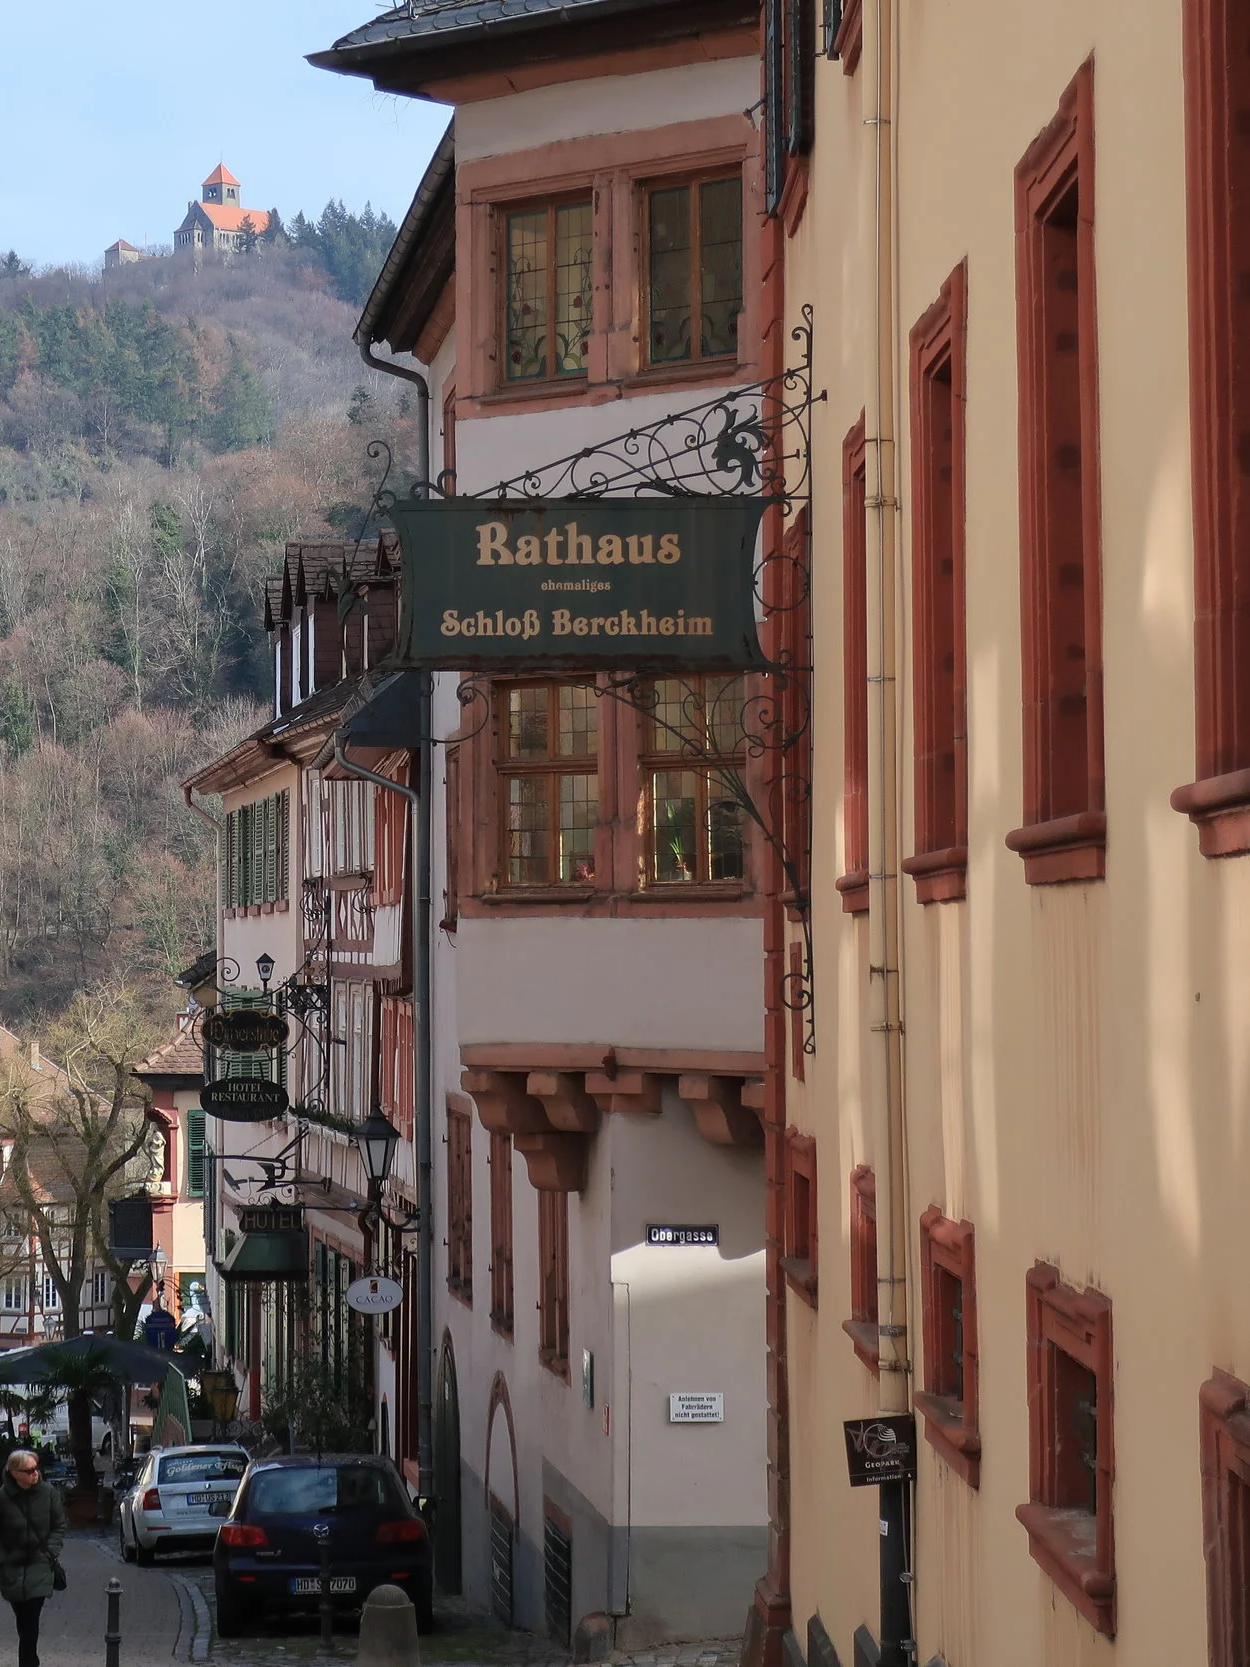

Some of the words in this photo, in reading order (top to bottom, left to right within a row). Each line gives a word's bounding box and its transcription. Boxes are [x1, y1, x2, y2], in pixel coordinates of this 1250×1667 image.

[476, 521, 681, 566] Rathaus
[541, 579, 611, 593] ehemaliges
[440, 609, 540, 640] Schloß
[551, 608, 714, 636] Berckheim
[228, 1083, 262, 1092] HOTEL
[211, 1092, 280, 1102] RESTAURANT
[651, 1228, 713, 1244] Obergasse
[355, 1295, 393, 1304] CACAO
[166, 1462, 213, 1477] Goldener
[866, 1474, 902, 1482] Information
[330, 1577, 355, 1590] 7070
